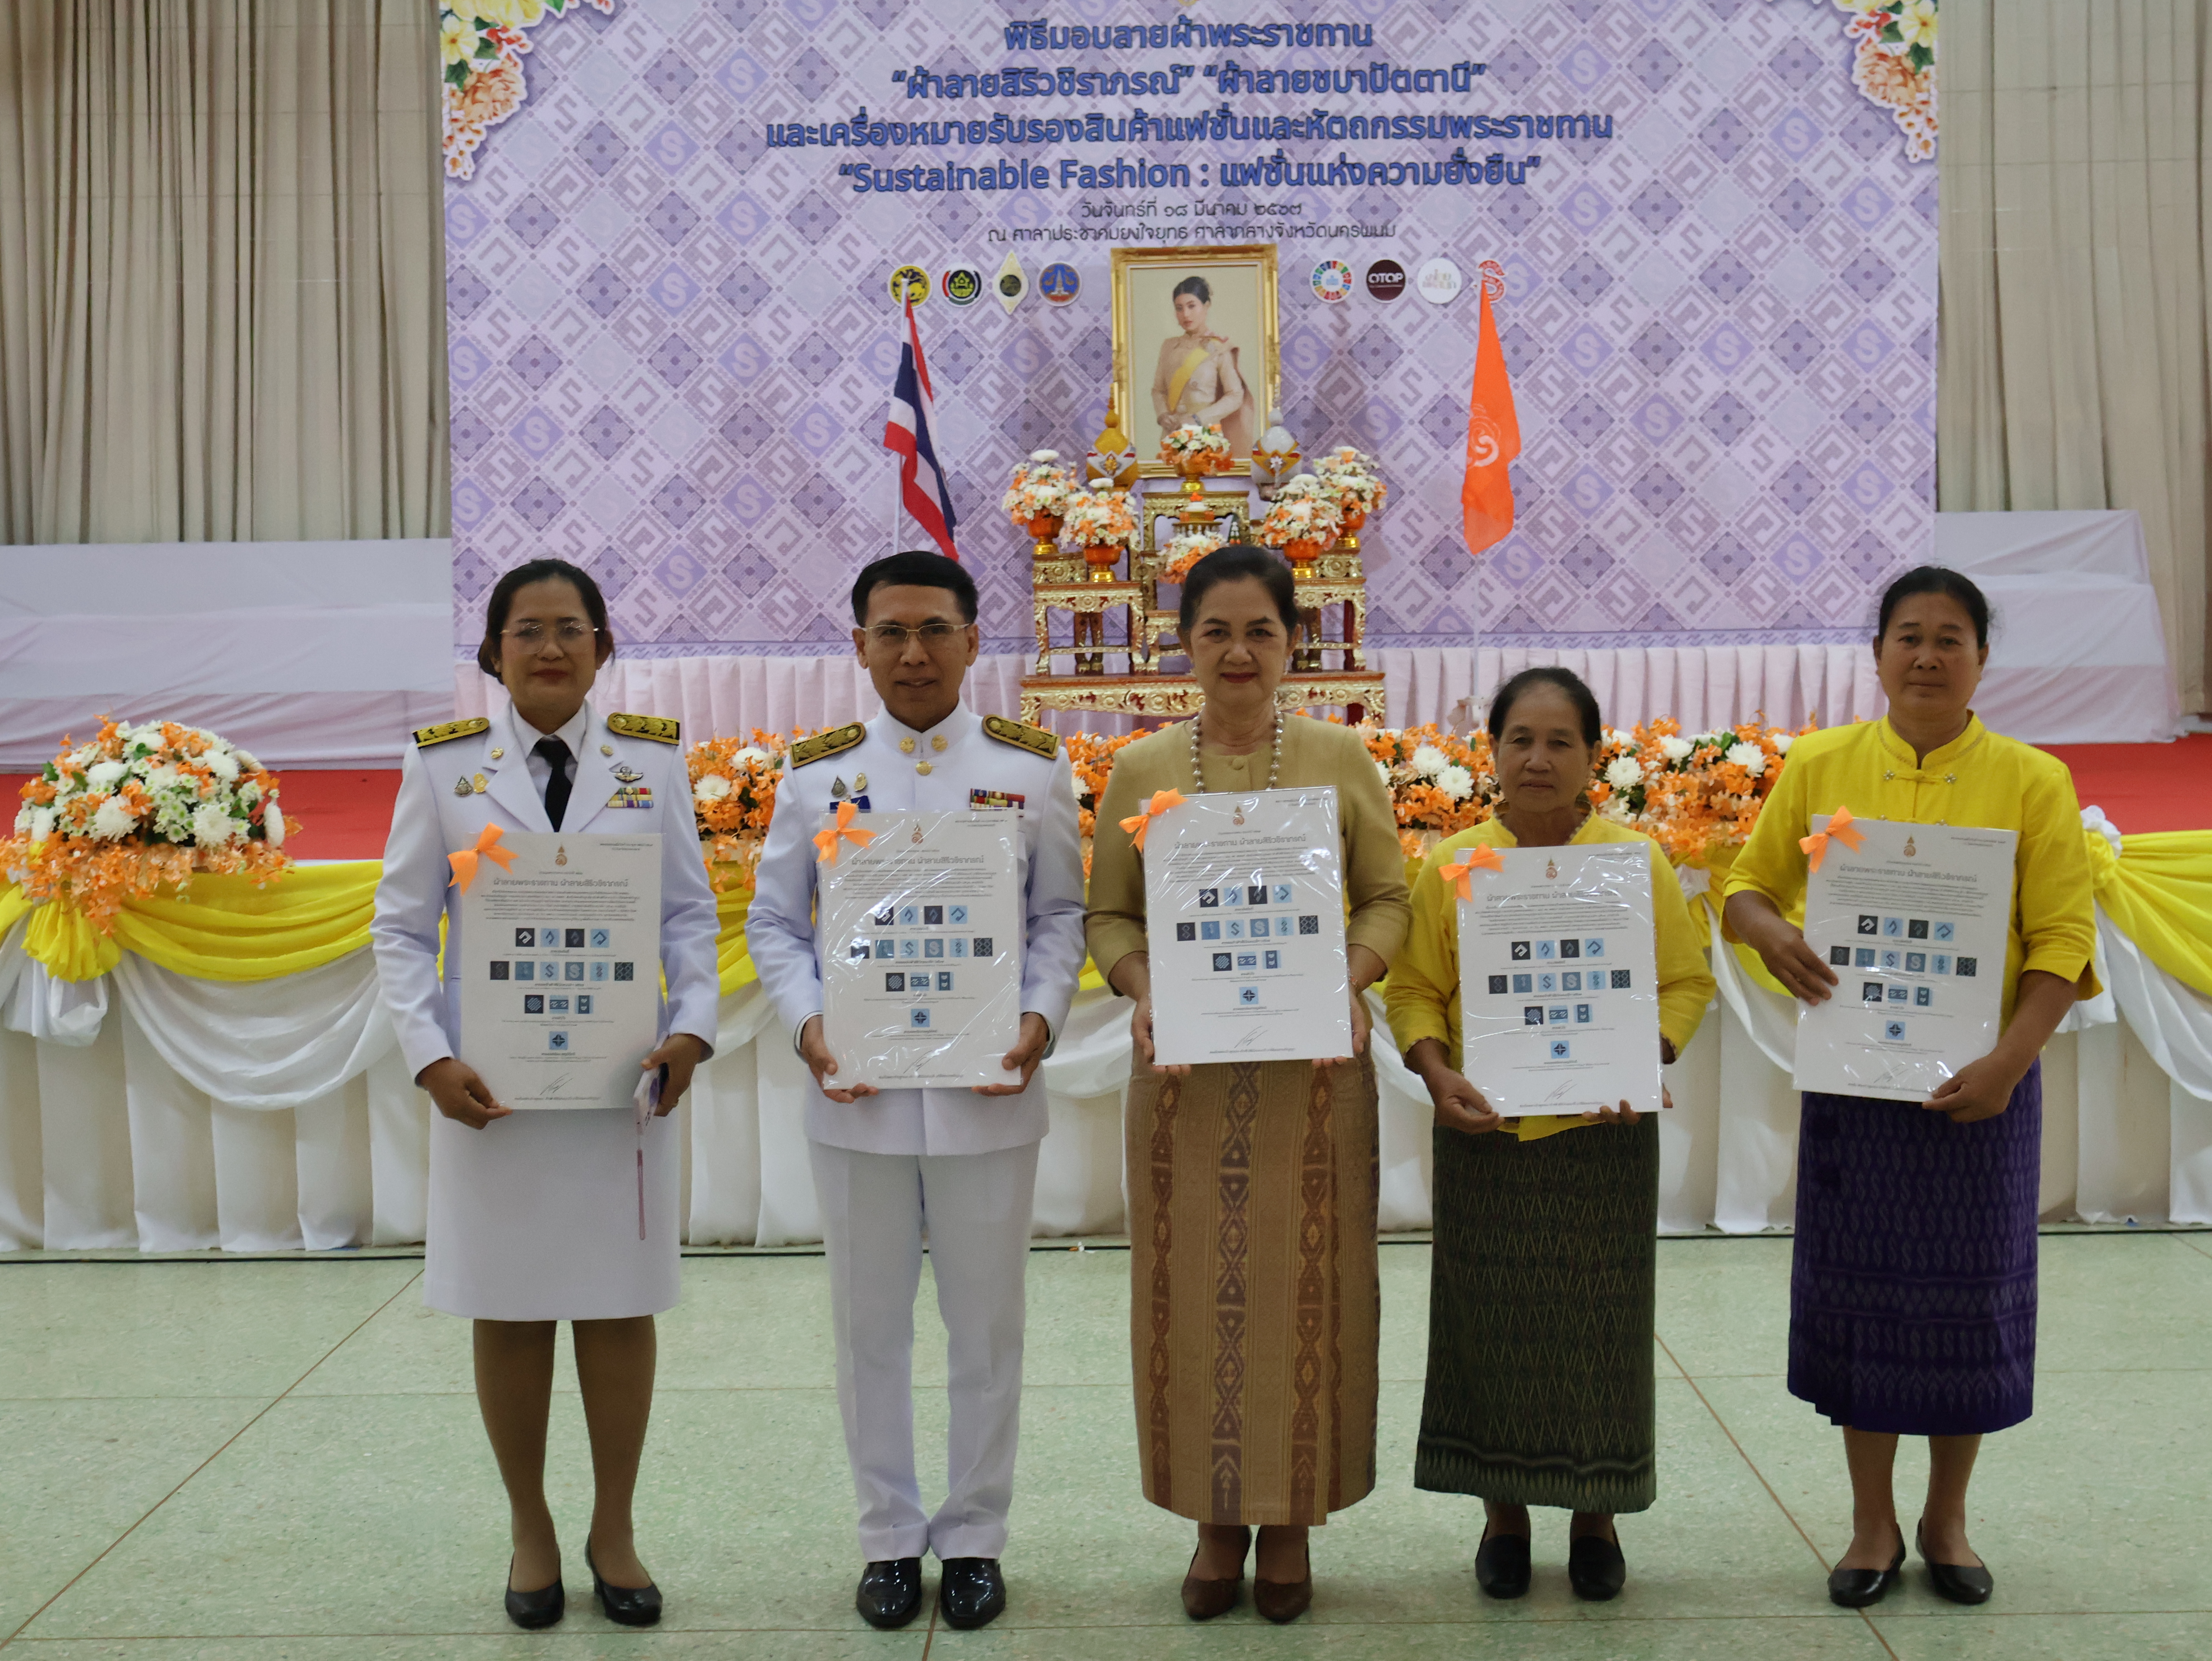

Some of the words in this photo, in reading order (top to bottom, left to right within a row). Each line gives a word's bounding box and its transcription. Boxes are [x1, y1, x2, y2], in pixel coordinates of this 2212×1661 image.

[1004, 14, 1373, 50] พิธีมอบลายผ้าพระราชทาน
[767, 103, 1613, 147] และเครื่องหมายรับรองสินค้าแฟชั่นและหัตถกรรมพระราชทาน
[839, 159, 1050, 192] “Sustainable
[1060, 158, 1190, 190] Fashion
[1220, 147, 1542, 187] แฟชั่นแห่งความยั่งยืน”
[1082, 196, 1157, 217] วันจันทร์ที่
[1164, 204, 1188, 216] ๑๘
[1194, 198, 1247, 216] มีนาคม
[988, 228, 1006, 242] ณ
[1368, 272, 1404, 284] OTOP
